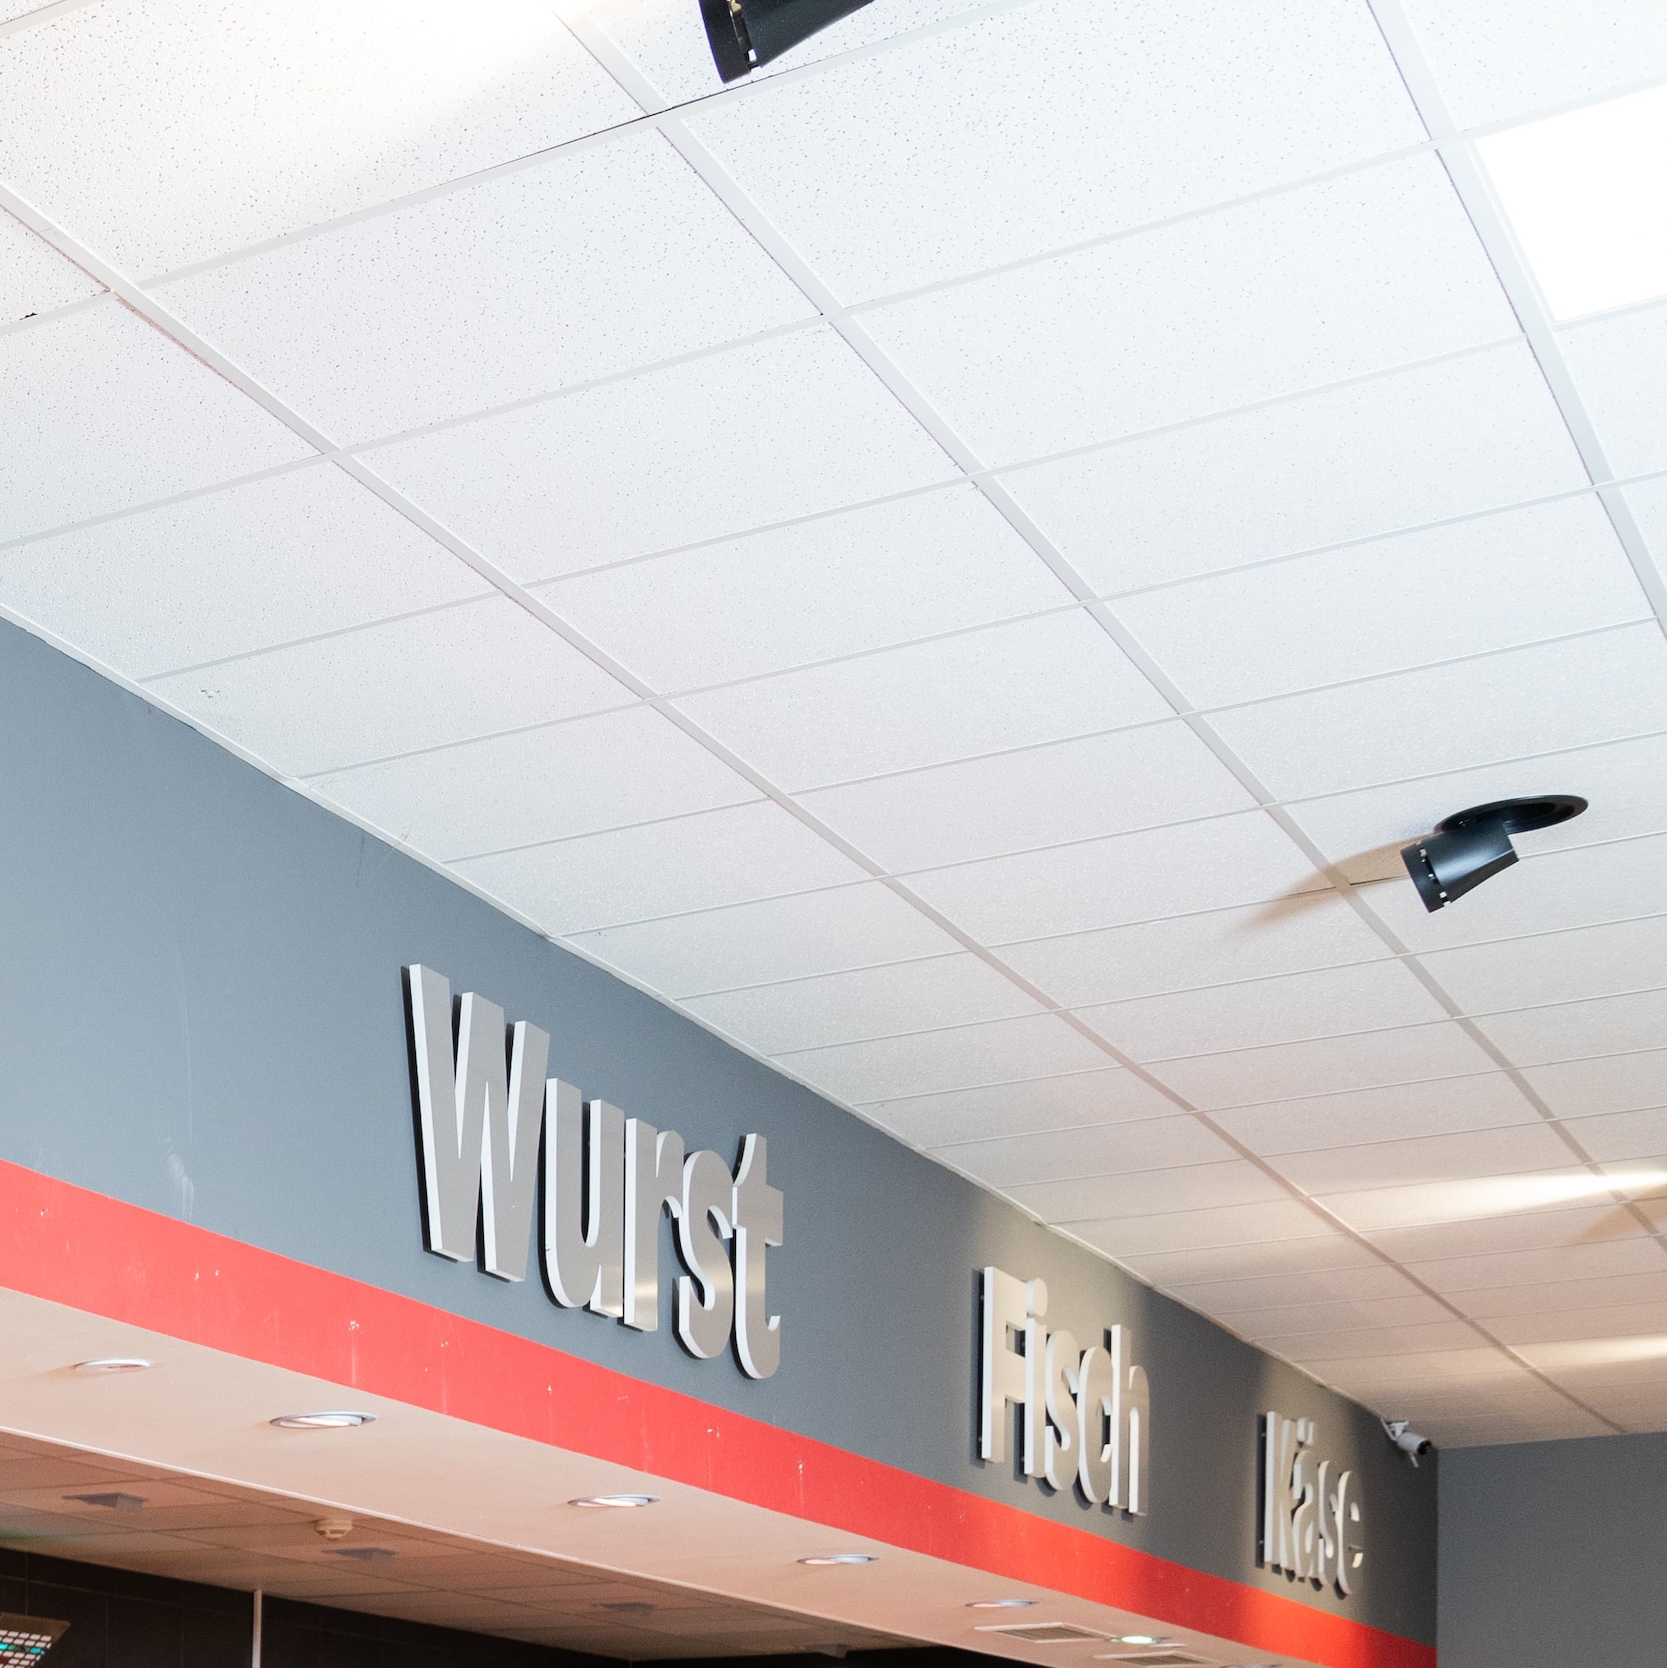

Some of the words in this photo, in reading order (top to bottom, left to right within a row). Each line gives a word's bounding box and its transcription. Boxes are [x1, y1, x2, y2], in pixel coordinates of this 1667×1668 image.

[408, 964, 784, 1380] Wurst
[981, 1267, 1150, 1517] Fisch
[1263, 1410, 1363, 1596] Käse
